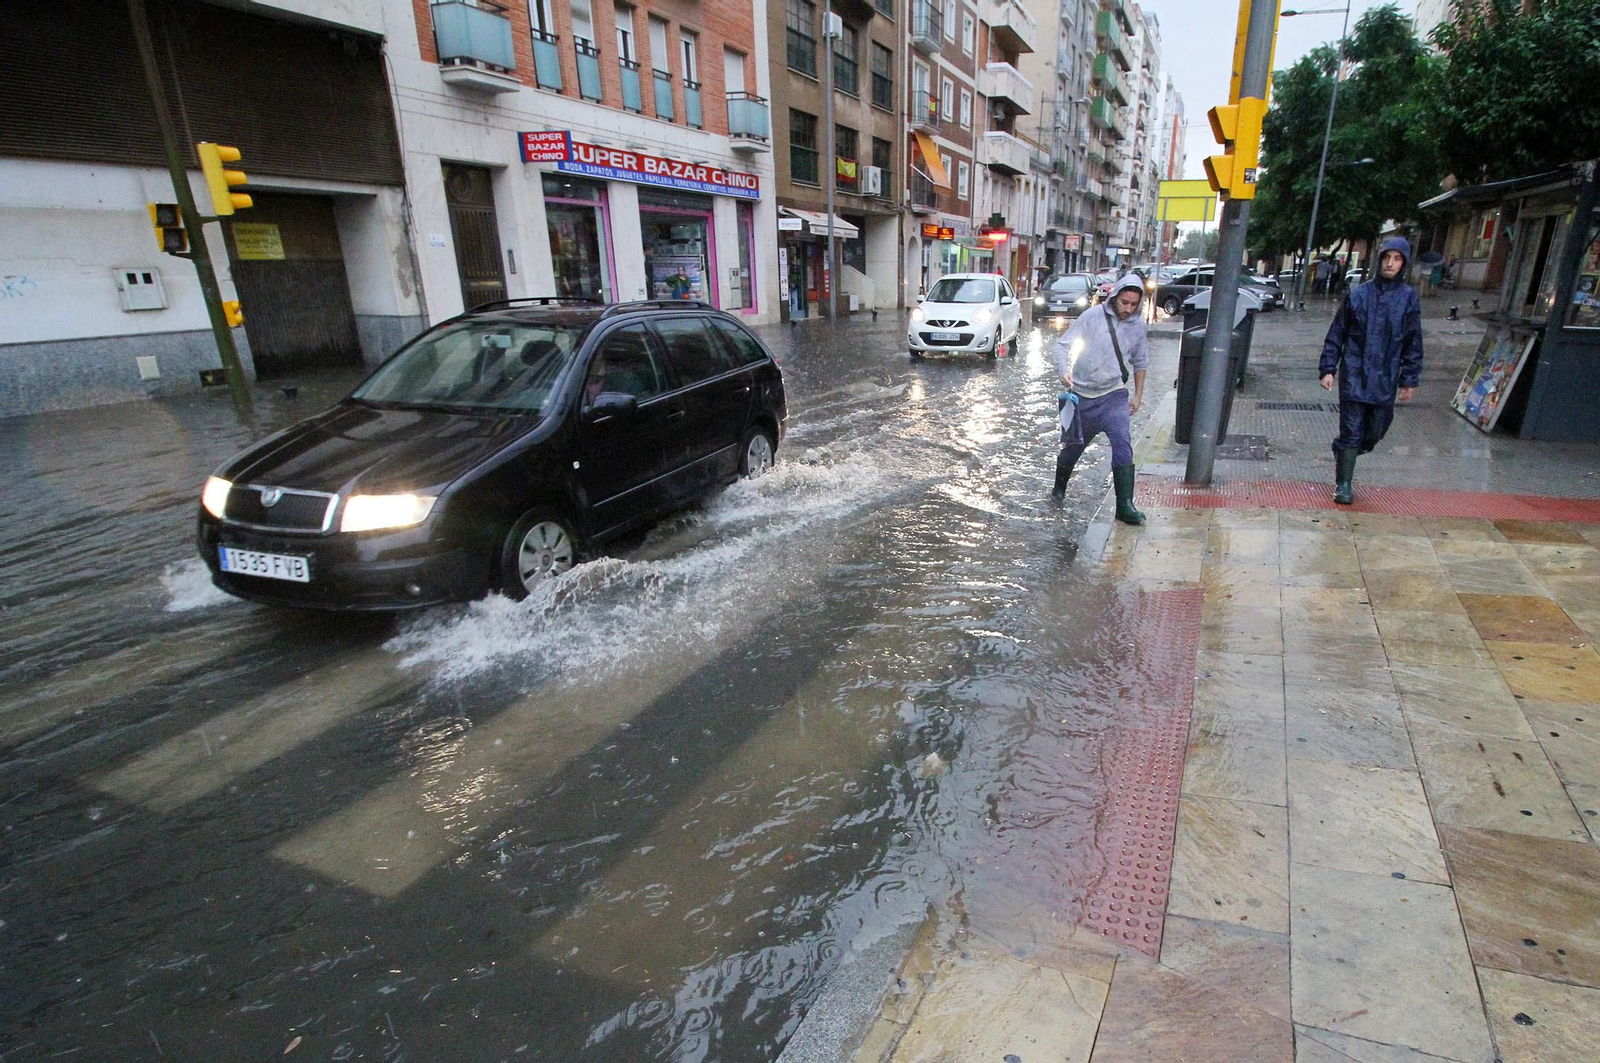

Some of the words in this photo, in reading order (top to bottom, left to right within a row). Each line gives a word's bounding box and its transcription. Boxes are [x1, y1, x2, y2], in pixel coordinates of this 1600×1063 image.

[527, 132, 563, 142] SUPER
[527, 142, 565, 151] BAZAR
[531, 152, 564, 160] CHINO
[643, 157, 708, 182] BAZAR
[712, 170, 757, 189] CHINO
[230, 550, 268, 573] 1535
[273, 556, 304, 578] FVB
